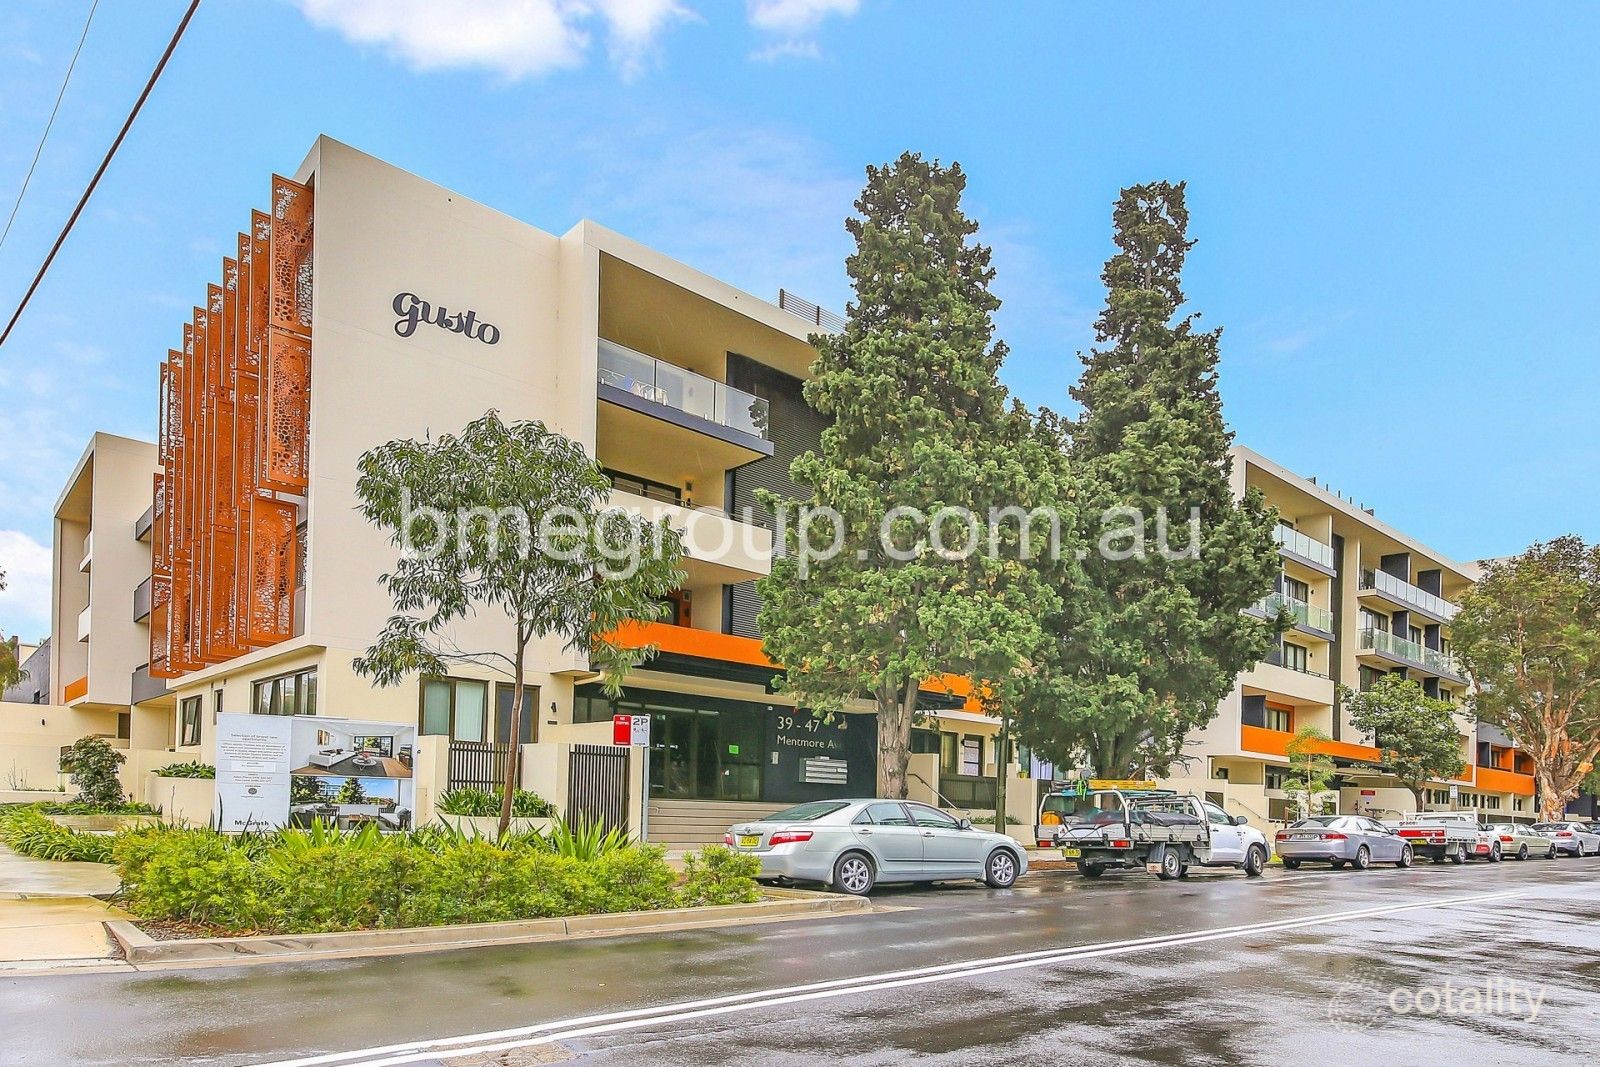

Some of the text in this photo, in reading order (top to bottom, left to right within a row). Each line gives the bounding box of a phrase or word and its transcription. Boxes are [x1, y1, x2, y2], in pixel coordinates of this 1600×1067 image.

[392, 292, 500, 345] gusto
[633, 717, 648, 726] 2P
[777, 716, 793, 730] 39
[805, 719, 820, 732] 47
[777, 735, 825, 748] Mentmore
